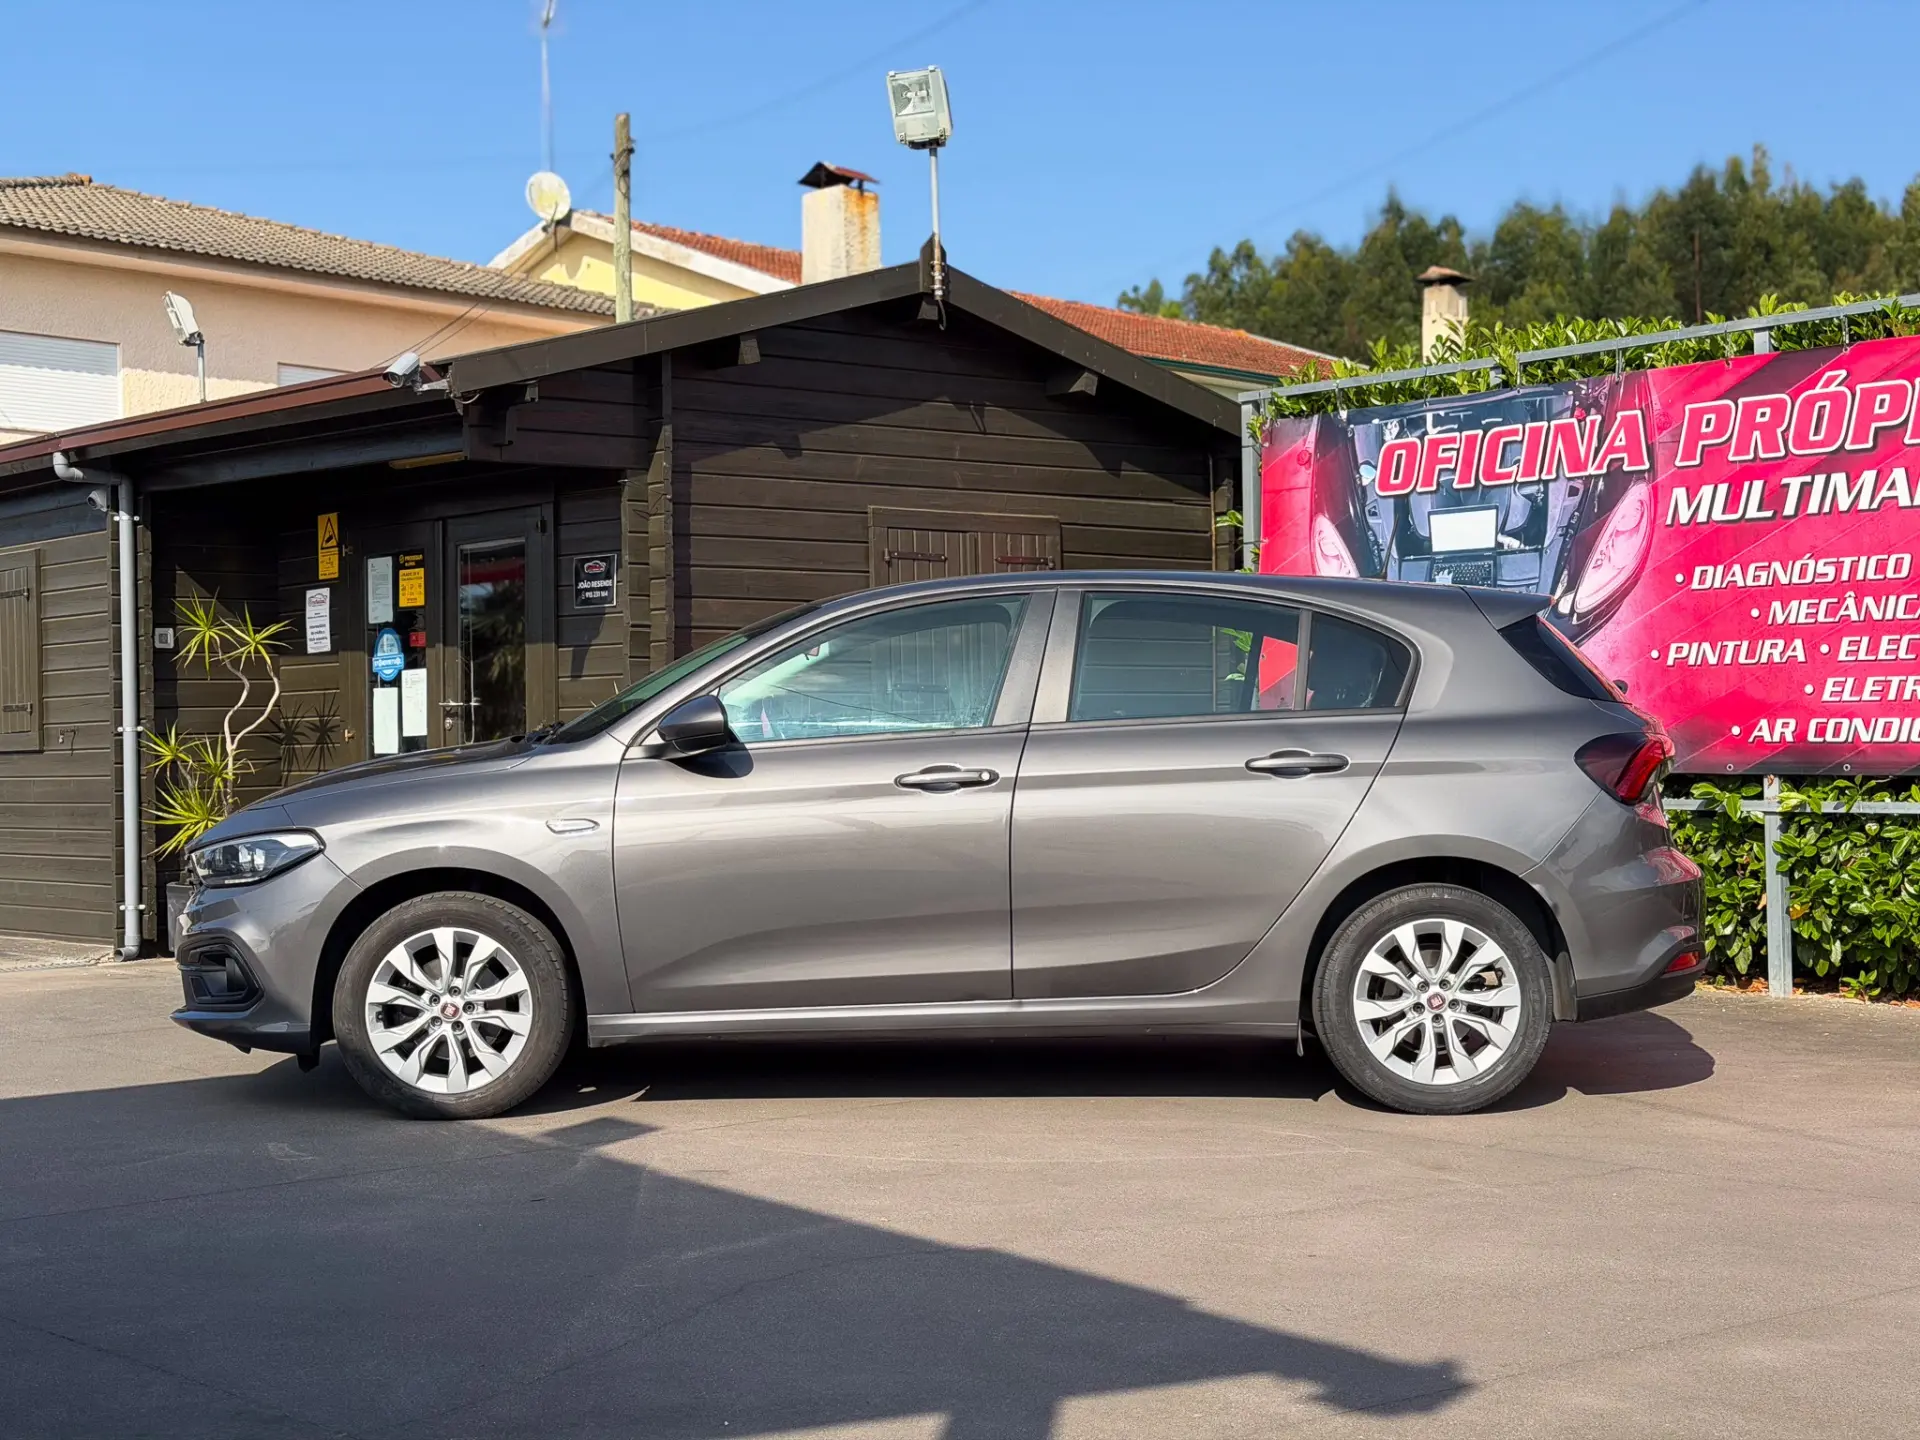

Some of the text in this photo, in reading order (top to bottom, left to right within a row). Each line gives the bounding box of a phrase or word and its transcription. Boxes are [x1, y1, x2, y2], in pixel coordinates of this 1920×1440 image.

[1375, 410, 1649, 496] OFICINA
[1665, 467, 1920, 525] MULTIMA
[1691, 553, 1912, 590] DIAGNÓSTICO
[1767, 591, 1920, 625] MECÂNIC
[1666, 634, 1920, 667] PINTURA ELEC
[1748, 718, 1797, 743] AR
